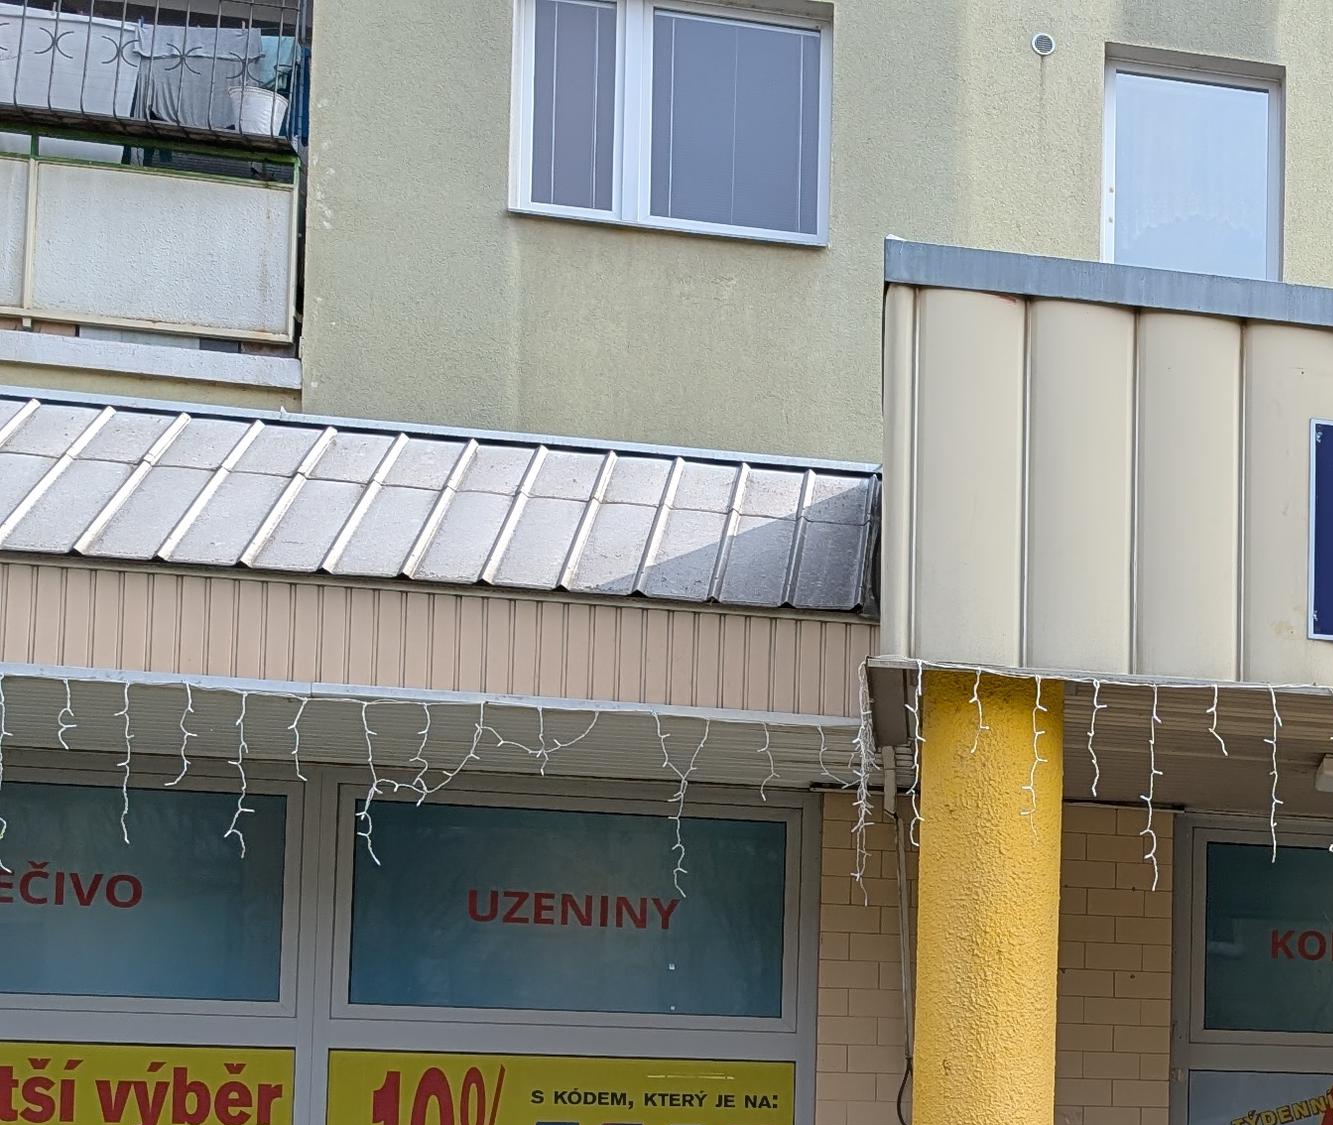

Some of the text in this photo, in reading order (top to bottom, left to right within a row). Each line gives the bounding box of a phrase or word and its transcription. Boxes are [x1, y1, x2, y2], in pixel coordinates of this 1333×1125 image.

[467, 888, 680, 931] UZENINY
[531, 1087, 779, 1110] S KÓDEM, KTERÝ JE NA:
